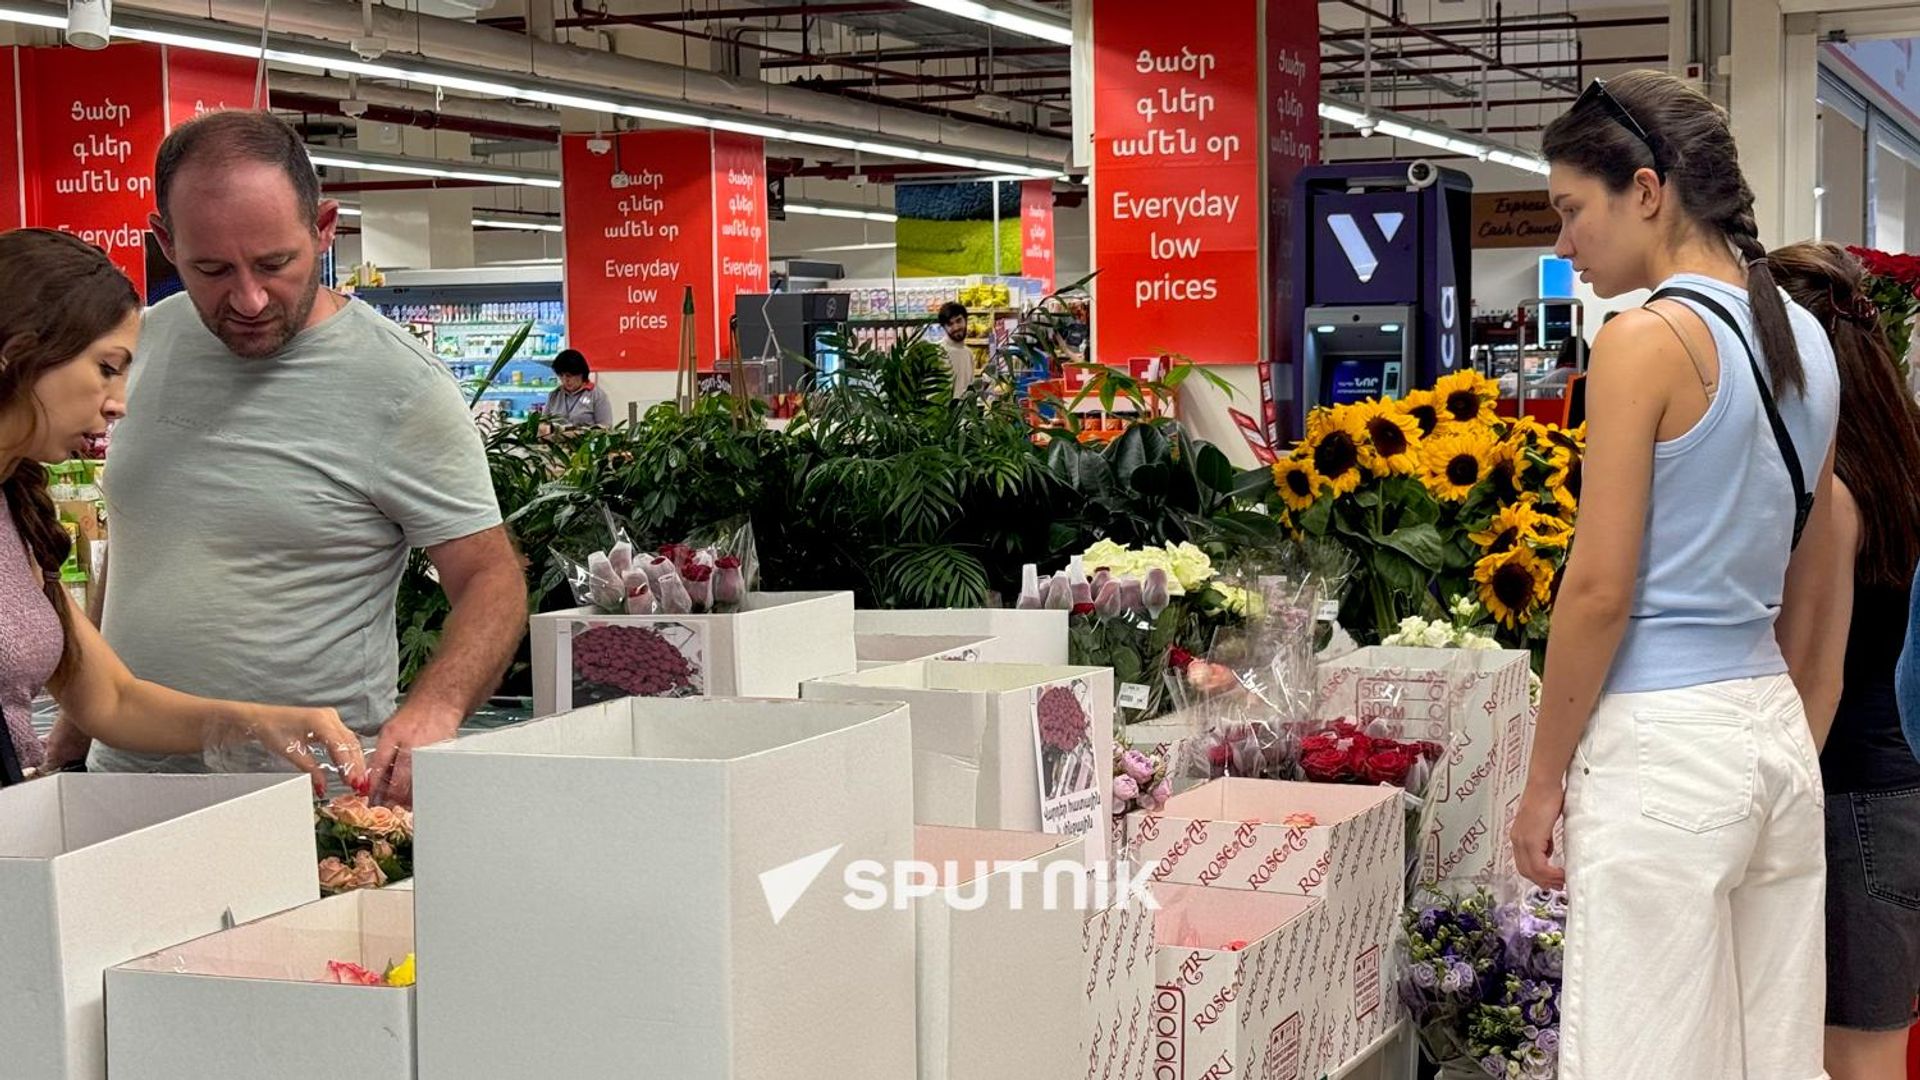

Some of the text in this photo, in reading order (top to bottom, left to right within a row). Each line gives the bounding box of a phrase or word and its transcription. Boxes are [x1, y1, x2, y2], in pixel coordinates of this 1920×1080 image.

[1136, 46, 1215, 79] Ցածր
[71, 98, 131, 127] Ցածր
[1136, 86, 1215, 122] գներ
[73, 134, 132, 163] գներ
[1112, 128, 1240, 161] ամեն օր
[56, 170, 151, 199] ամեն օր
[612, 168, 664, 191] ածր
[618, 195, 664, 216] գներ
[1112, 188, 1240, 225] Everyday
[58, 223, 148, 254] eryda
[605, 220, 679, 241] ամեն օր
[1150, 232, 1201, 260] low
[605, 258, 680, 281] Everyday
[723, 256, 763, 281] Everyday
[628, 286, 658, 304] low
[1136, 272, 1218, 308] prices
[619, 311, 668, 334] prices
